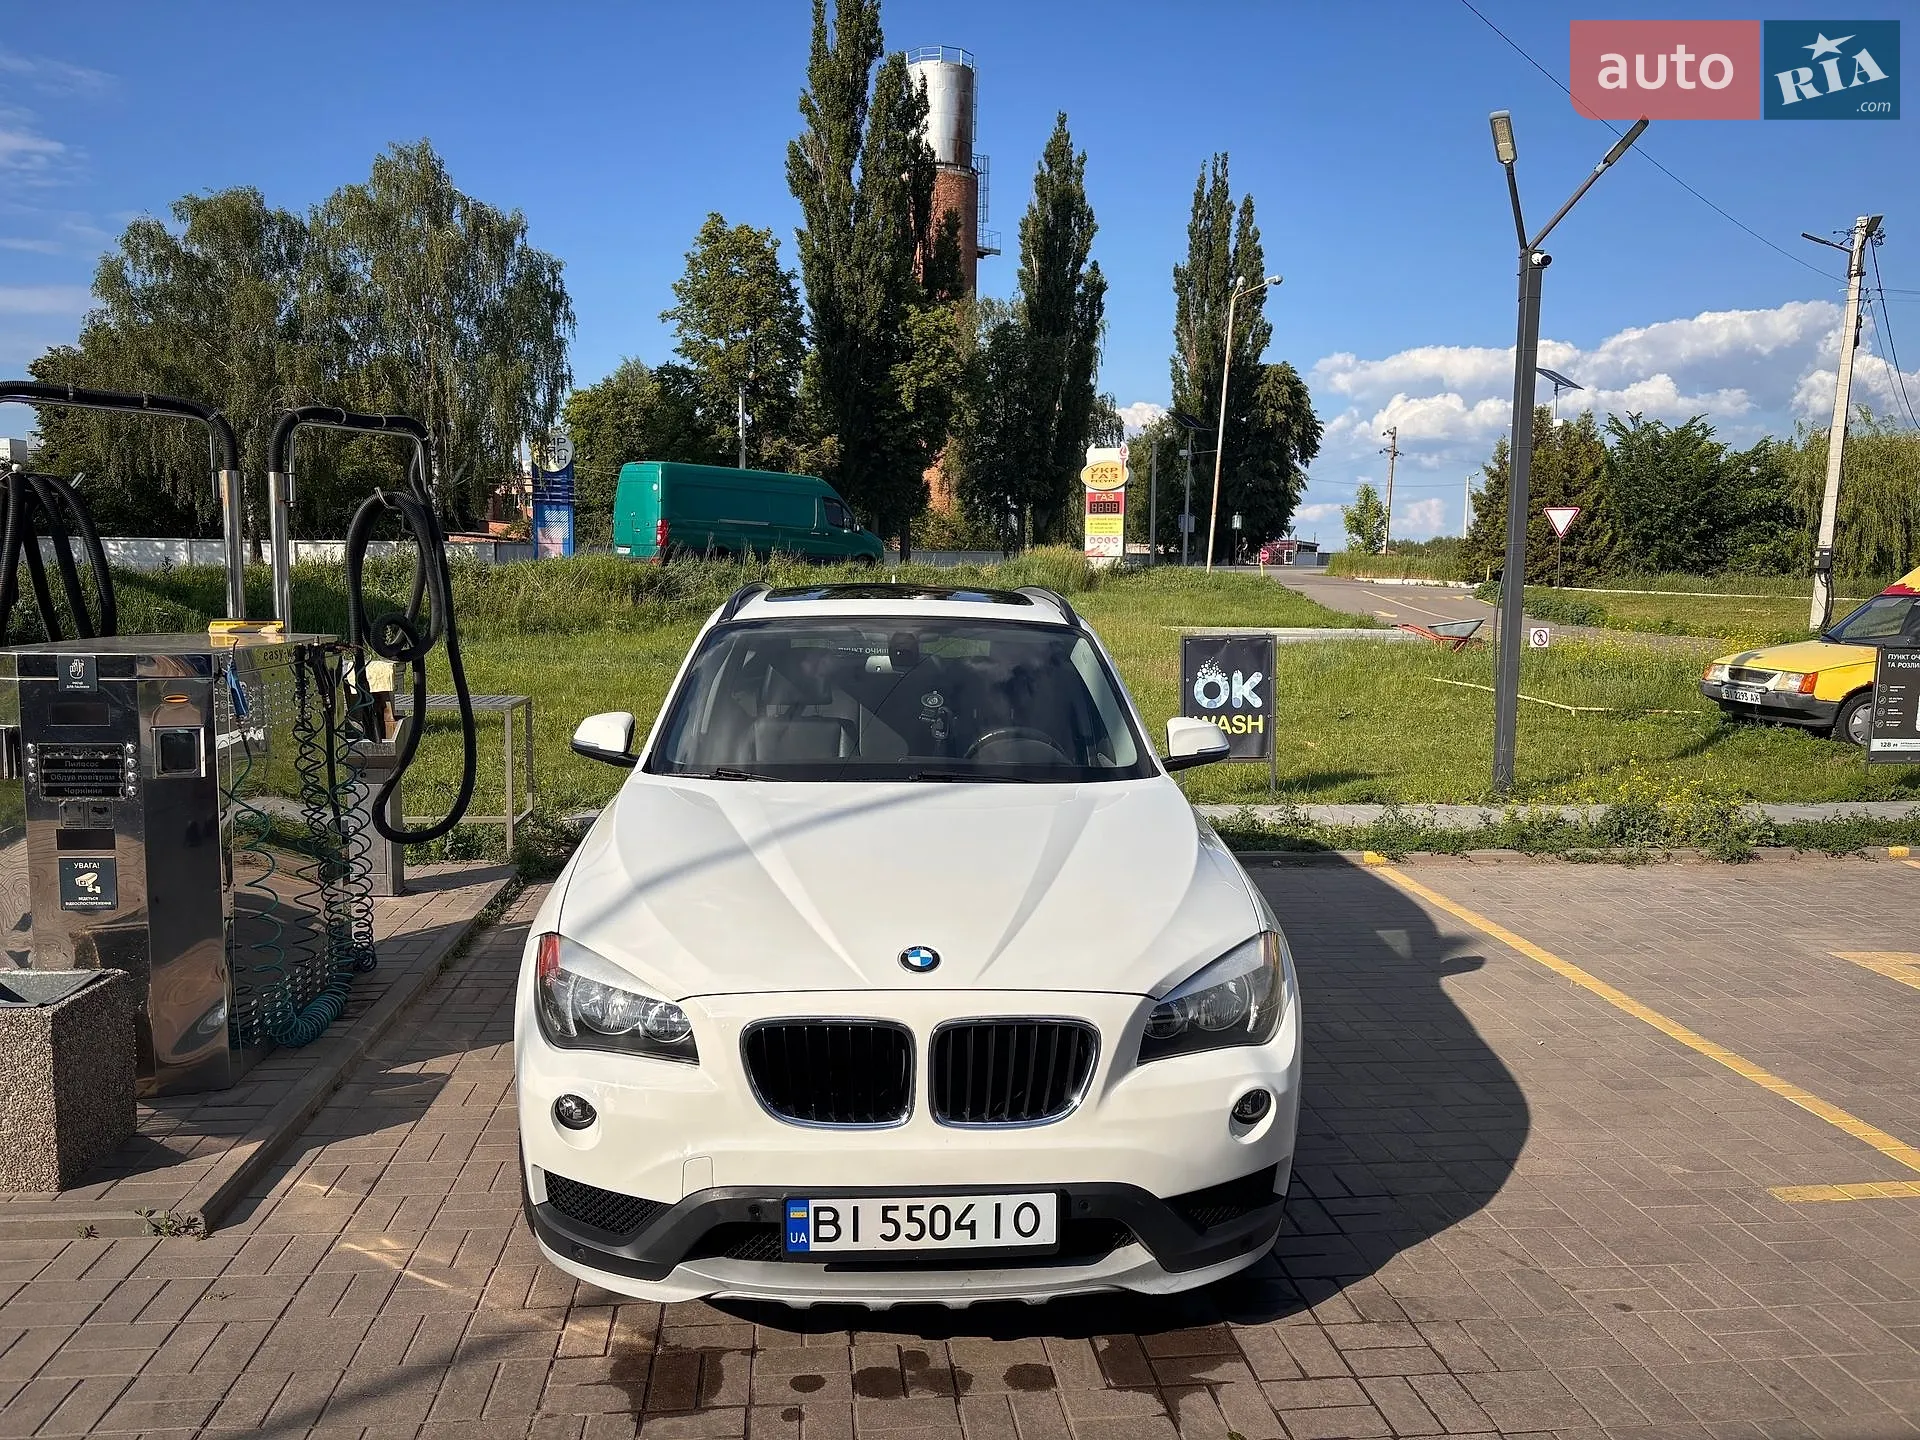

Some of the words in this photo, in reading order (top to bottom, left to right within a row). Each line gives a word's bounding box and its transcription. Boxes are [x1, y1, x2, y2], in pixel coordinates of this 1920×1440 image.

[1095, 493, 1115, 501] ГАЗ
[1887, 652, 1910, 661] ПУНКТ
[1887, 661, 1897, 669] ТА
[1193, 670, 1263, 709] OK
[812, 1205, 859, 1243] BI
[879, 1203, 977, 1243] 5504
[994, 1202, 1041, 1240] IO
[790, 1232, 808, 1244] UA
